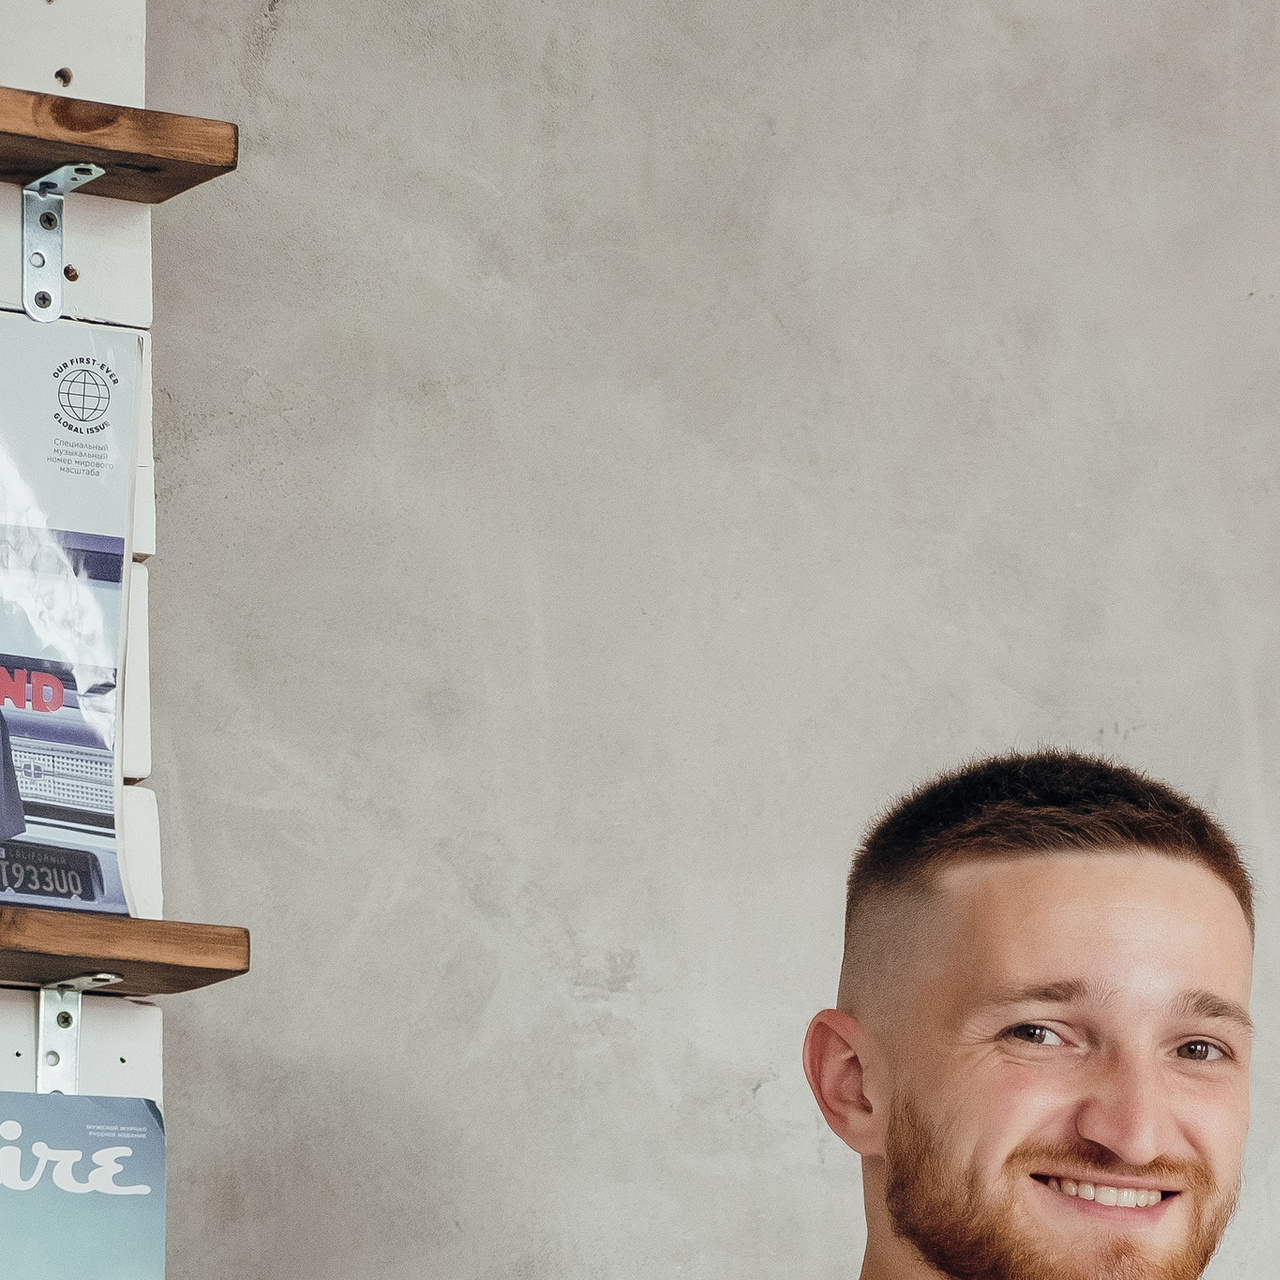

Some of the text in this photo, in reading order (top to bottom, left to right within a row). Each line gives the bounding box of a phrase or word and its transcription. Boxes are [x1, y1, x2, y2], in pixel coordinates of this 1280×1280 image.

[53, 357, 119, 385] OUR FIRST-EVER
[54, 413, 110, 434] GLOBAL ISSUE
[54, 438, 109, 451] Специальный
[53, 448, 108, 460] музыкальный
[47, 456, 114, 470] номер мирового
[60, 466, 100, 477] масштаба
